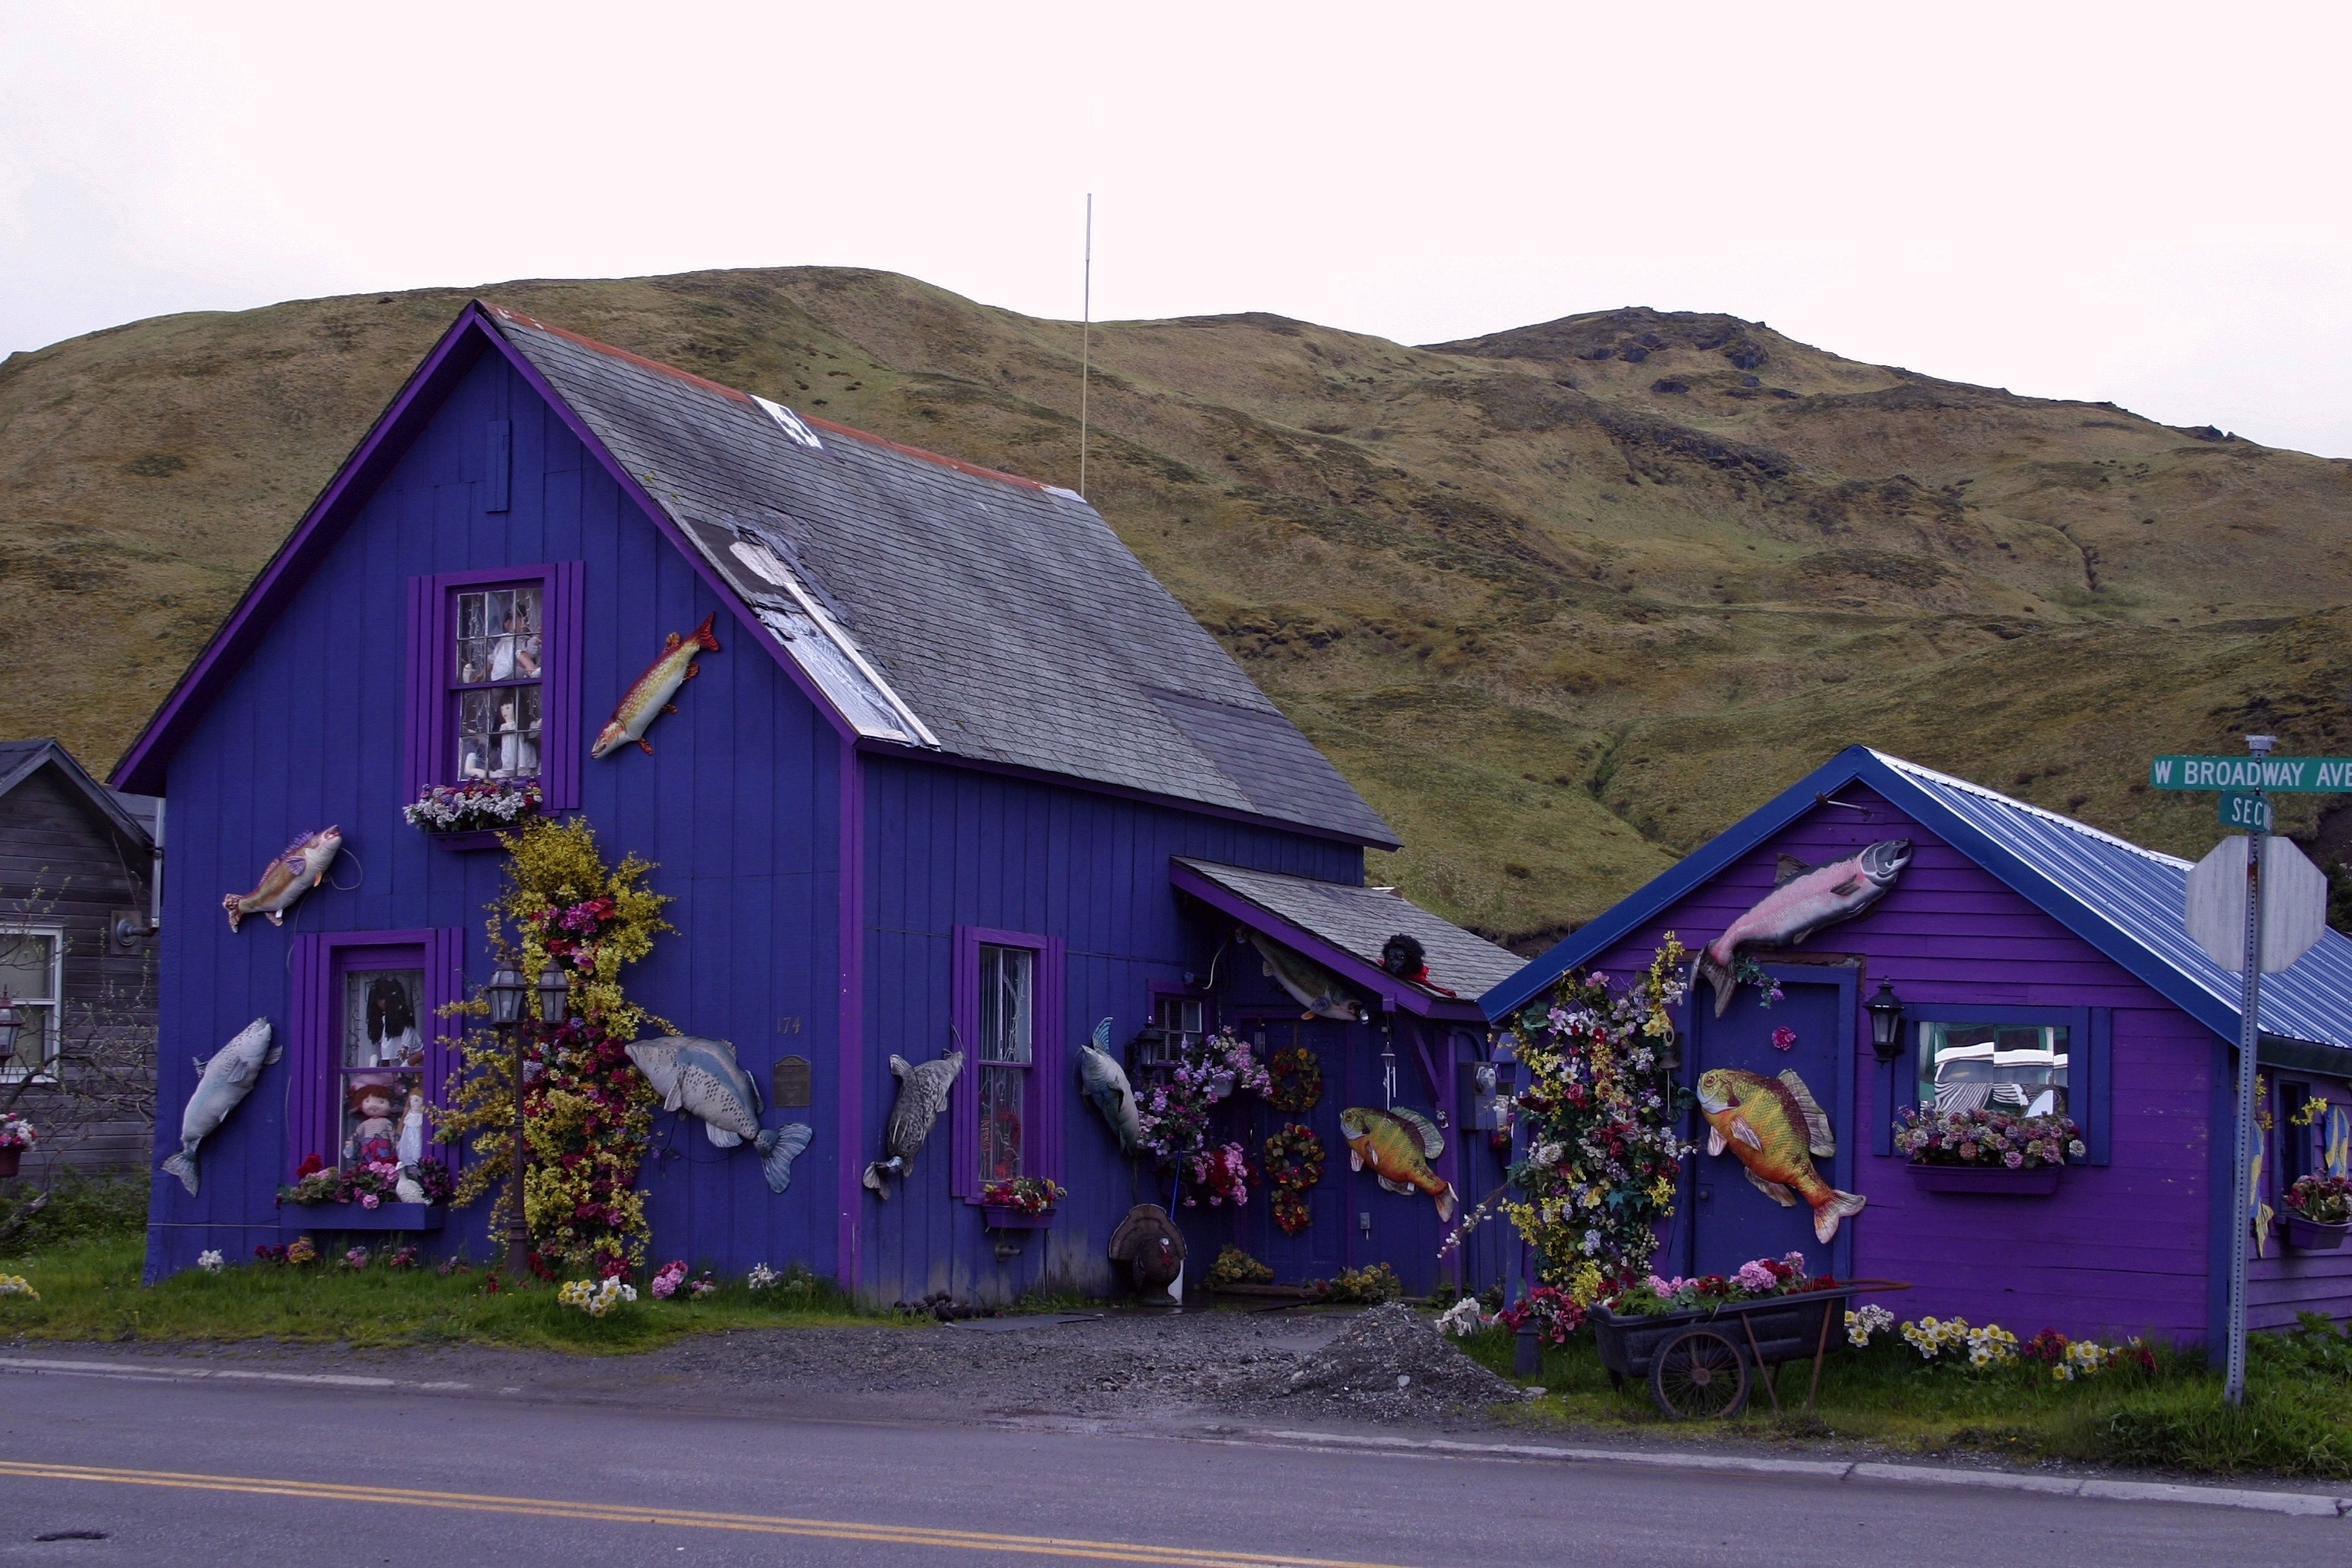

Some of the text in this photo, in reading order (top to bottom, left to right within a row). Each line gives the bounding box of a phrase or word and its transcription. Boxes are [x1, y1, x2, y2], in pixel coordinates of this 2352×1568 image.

[2154, 761, 2352, 787] W BROADWAY AVE
[2231, 797, 2266, 827] SEC
[776, 1017, 801, 1034] 174
